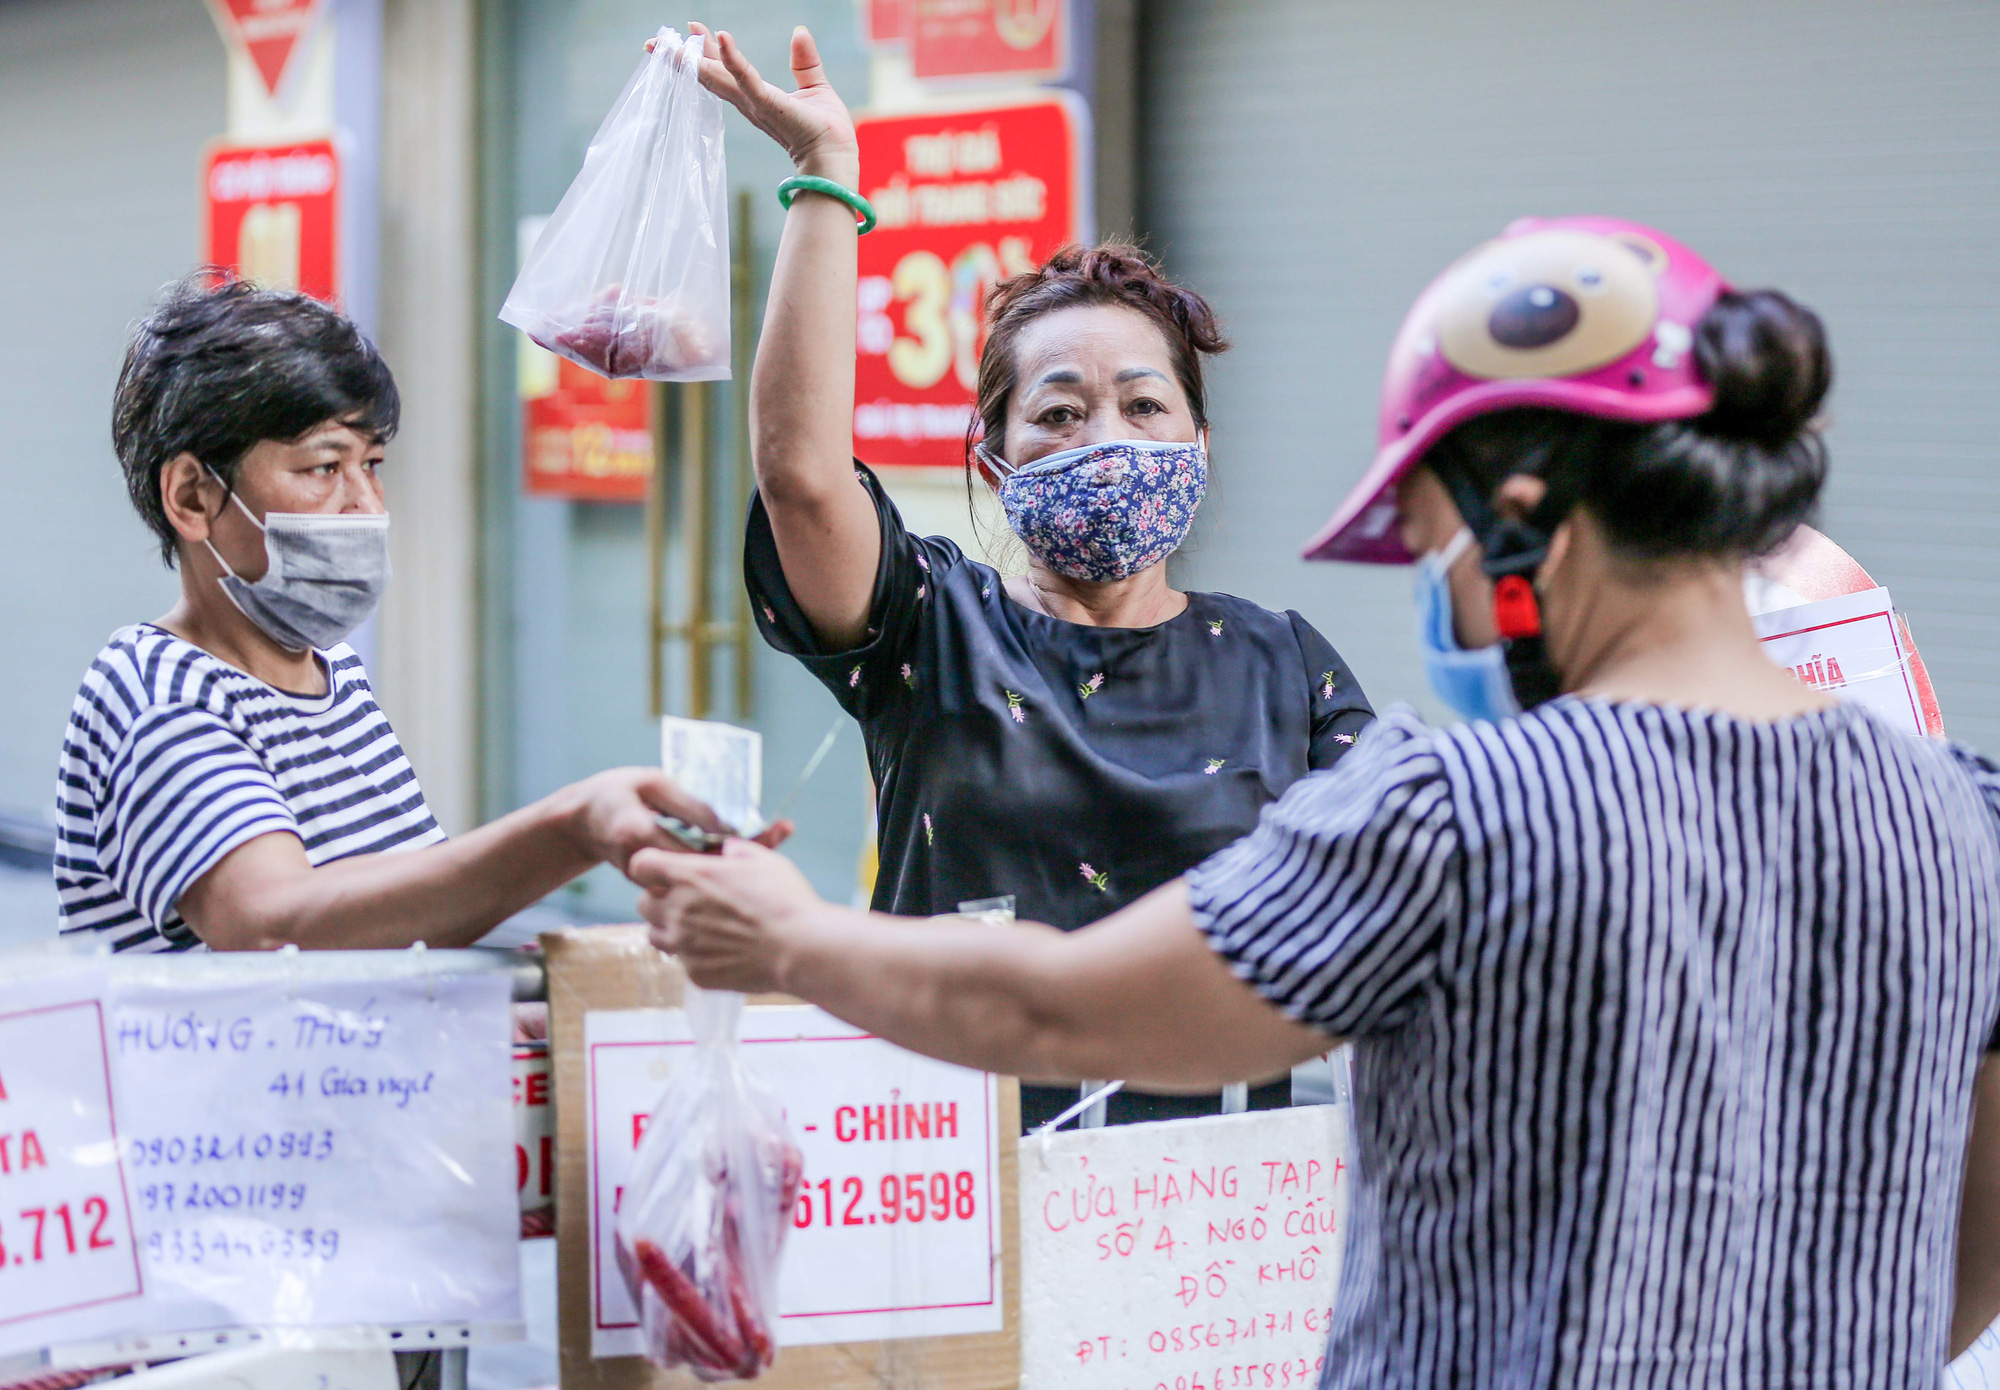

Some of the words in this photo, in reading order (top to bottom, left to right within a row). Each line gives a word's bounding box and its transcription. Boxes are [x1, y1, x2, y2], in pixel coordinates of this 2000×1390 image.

[1784, 653, 1848, 691] HĨA
[835, 1088, 958, 1142] CHỈNH
[138, 1181, 306, 1212] 972001199
[794, 1171, 975, 1229] 612.9598
[1134, 1156, 1238, 1210] HÀNG
